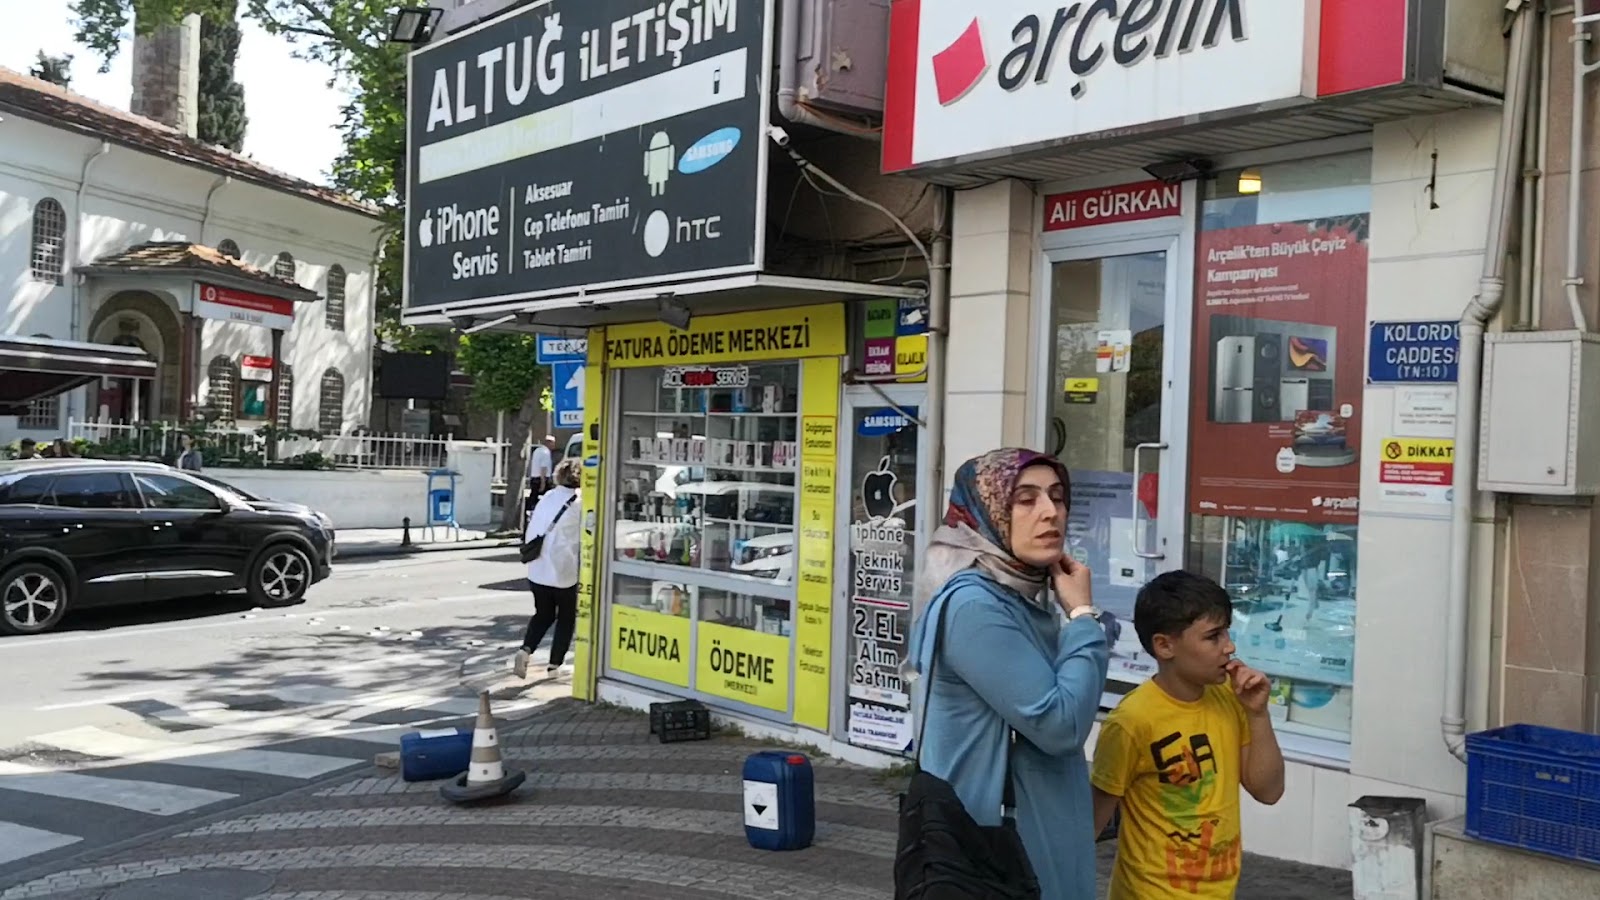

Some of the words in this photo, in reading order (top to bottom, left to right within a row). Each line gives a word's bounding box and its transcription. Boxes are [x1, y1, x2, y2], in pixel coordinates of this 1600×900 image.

[426, 12, 566, 132] ALTUĞ
[525, 180, 573, 204] Aksesuar
[1049, 200, 1077, 224] Ali
[1082, 184, 1179, 219] GÜRKAN
[436, 204, 499, 246] iPhone
[524, 218, 543, 239] Cep
[544, 208, 590, 233] Telefonu
[592, 197, 629, 223] Tamiri
[452, 246, 499, 280] Servis
[523, 249, 555, 270] Tablet
[556, 240, 592, 264] Tamiri
[606, 336, 664, 360] FATURA
[667, 329, 725, 356] ÖDEME
[728, 317, 810, 353] MERKEZİ
[864, 415, 908, 427] SAMSUNG
[1407, 445, 1453, 457] DİKKAT
[856, 550, 902, 571] Teknik
[855, 570, 901, 591] Servis
[854, 609, 902, 641] 2.EL
[618, 627, 681, 662] FATURA
[860, 642, 897, 665] Alım
[710, 639, 774, 684] ÖDEME
[855, 664, 901, 690] Satım
